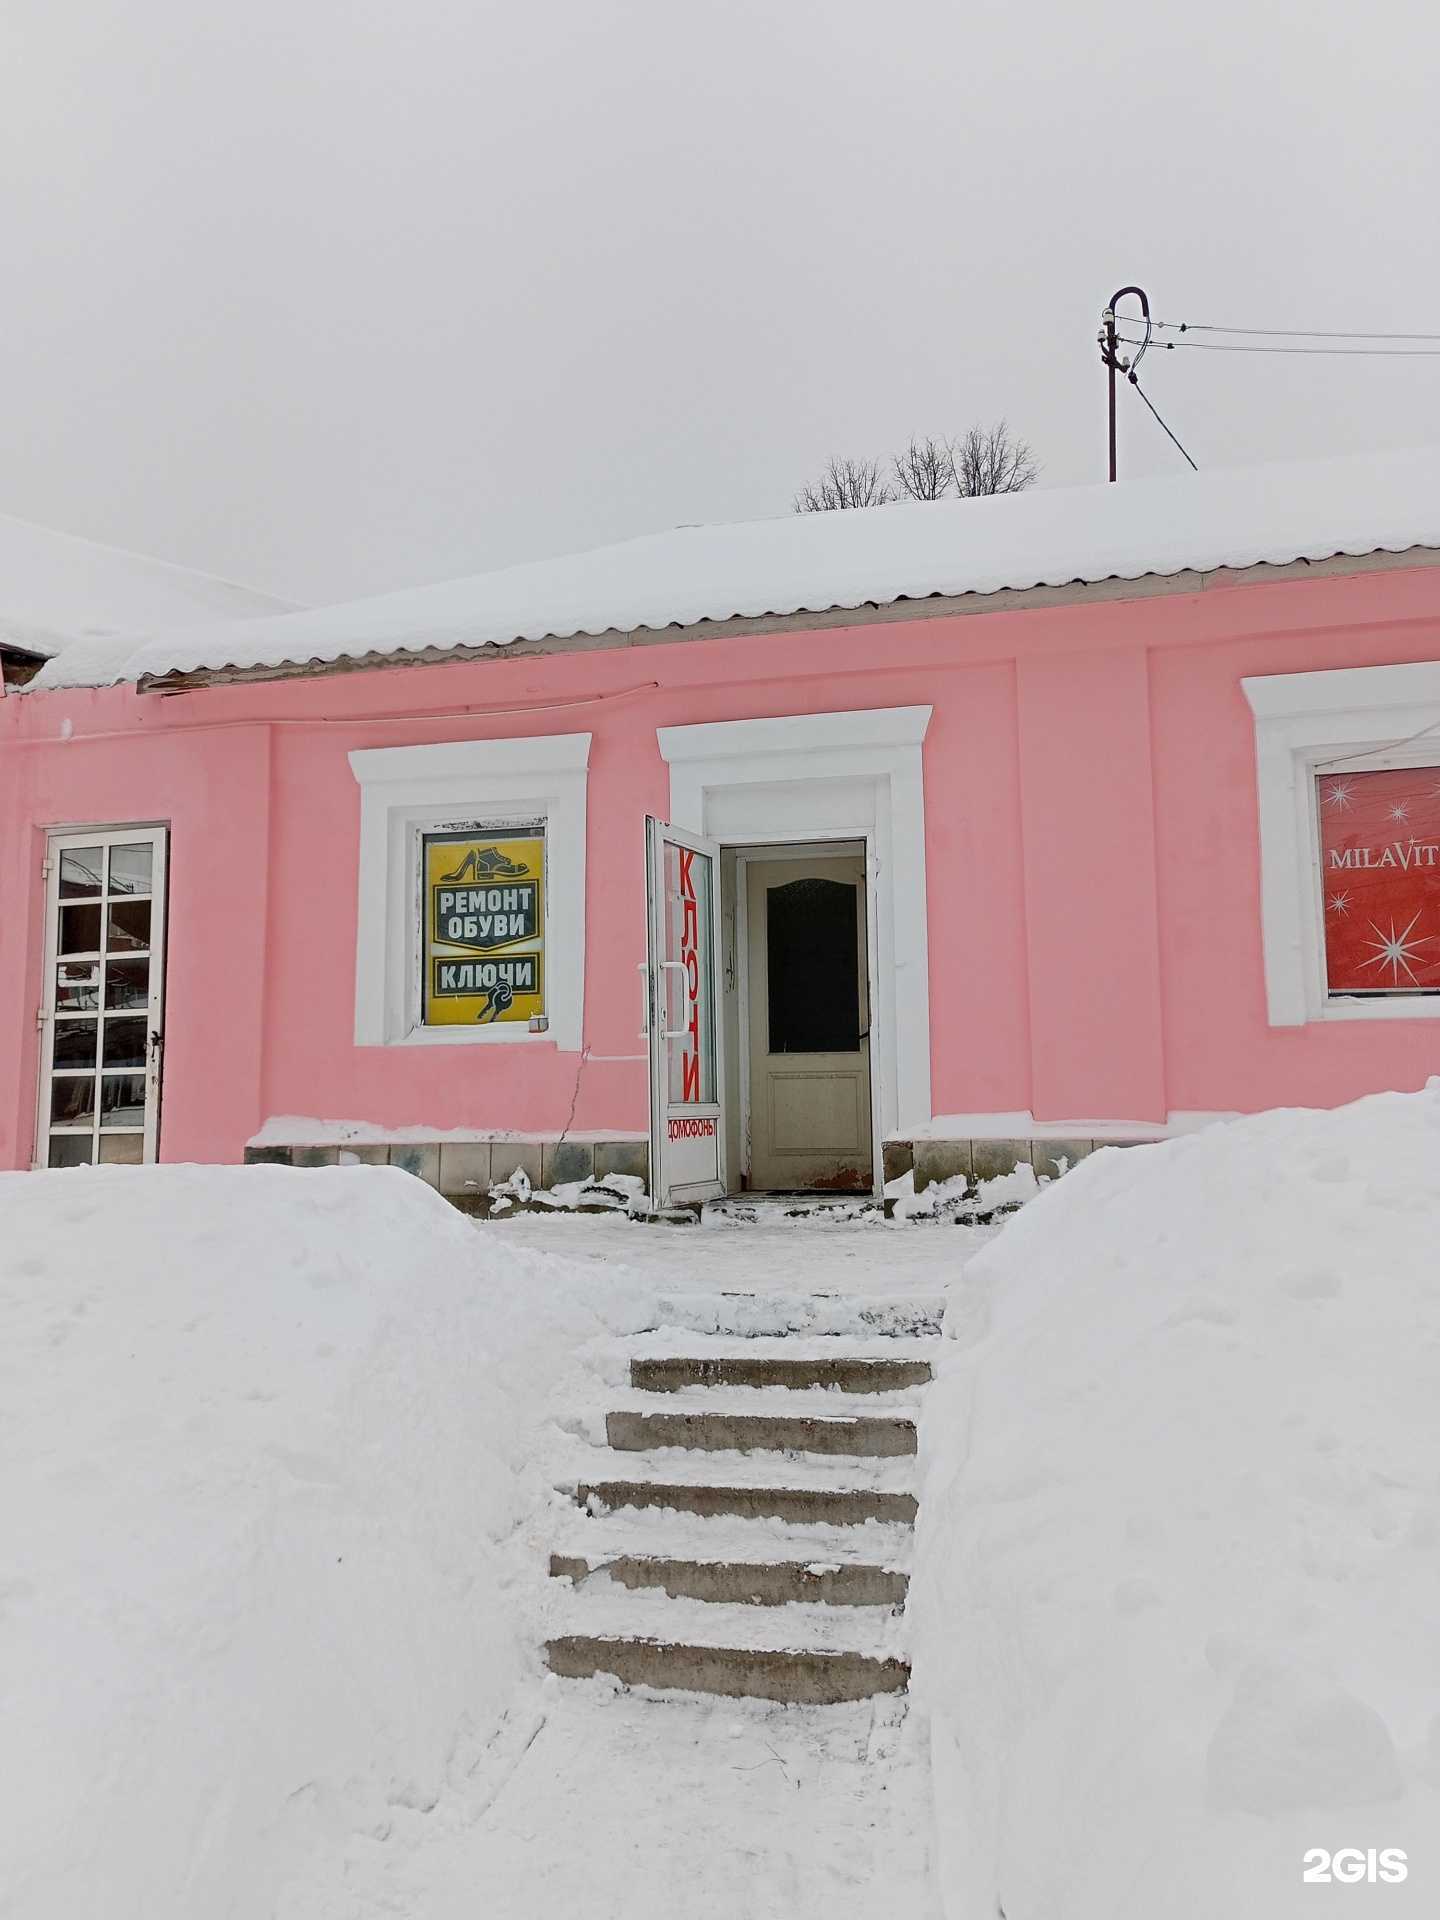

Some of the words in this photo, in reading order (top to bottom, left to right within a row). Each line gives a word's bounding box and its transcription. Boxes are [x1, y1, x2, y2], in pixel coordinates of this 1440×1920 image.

[440, 887, 532, 915] РЕМОНТ
[448, 913, 525, 939] ОБУВИ
[441, 962, 532, 989] КЛЮЧИ
[667, 1119, 716, 1143] ДОМОФОНЫ
